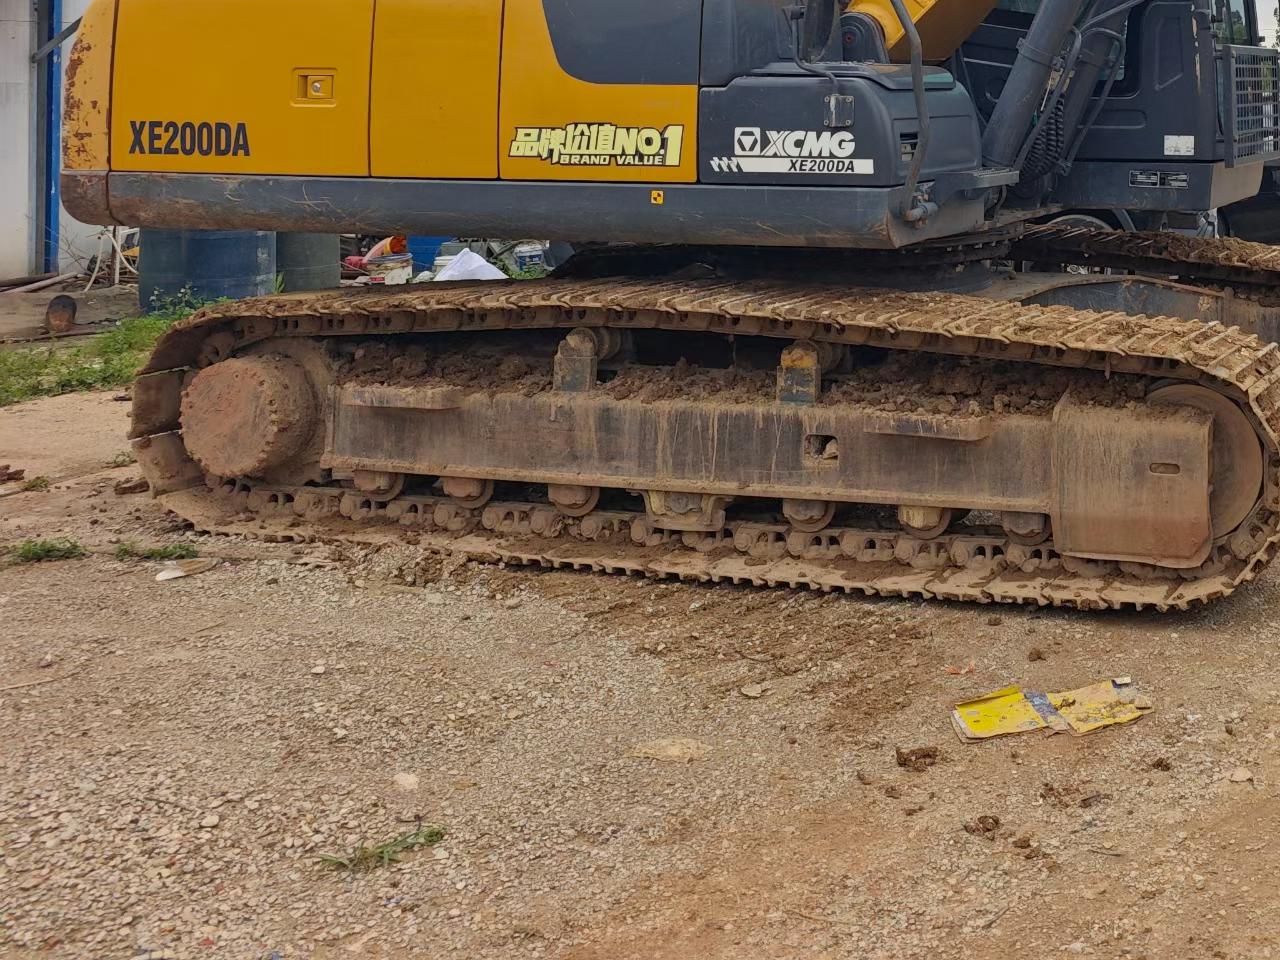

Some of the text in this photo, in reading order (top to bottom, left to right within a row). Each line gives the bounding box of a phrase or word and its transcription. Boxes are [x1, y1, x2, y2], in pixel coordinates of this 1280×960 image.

[129, 120, 250, 156] XE200DA
[760, 130, 856, 158] XCMG
[559, 154, 664, 165] BRAND VALUE
[788, 159, 855, 173] XE200DA
